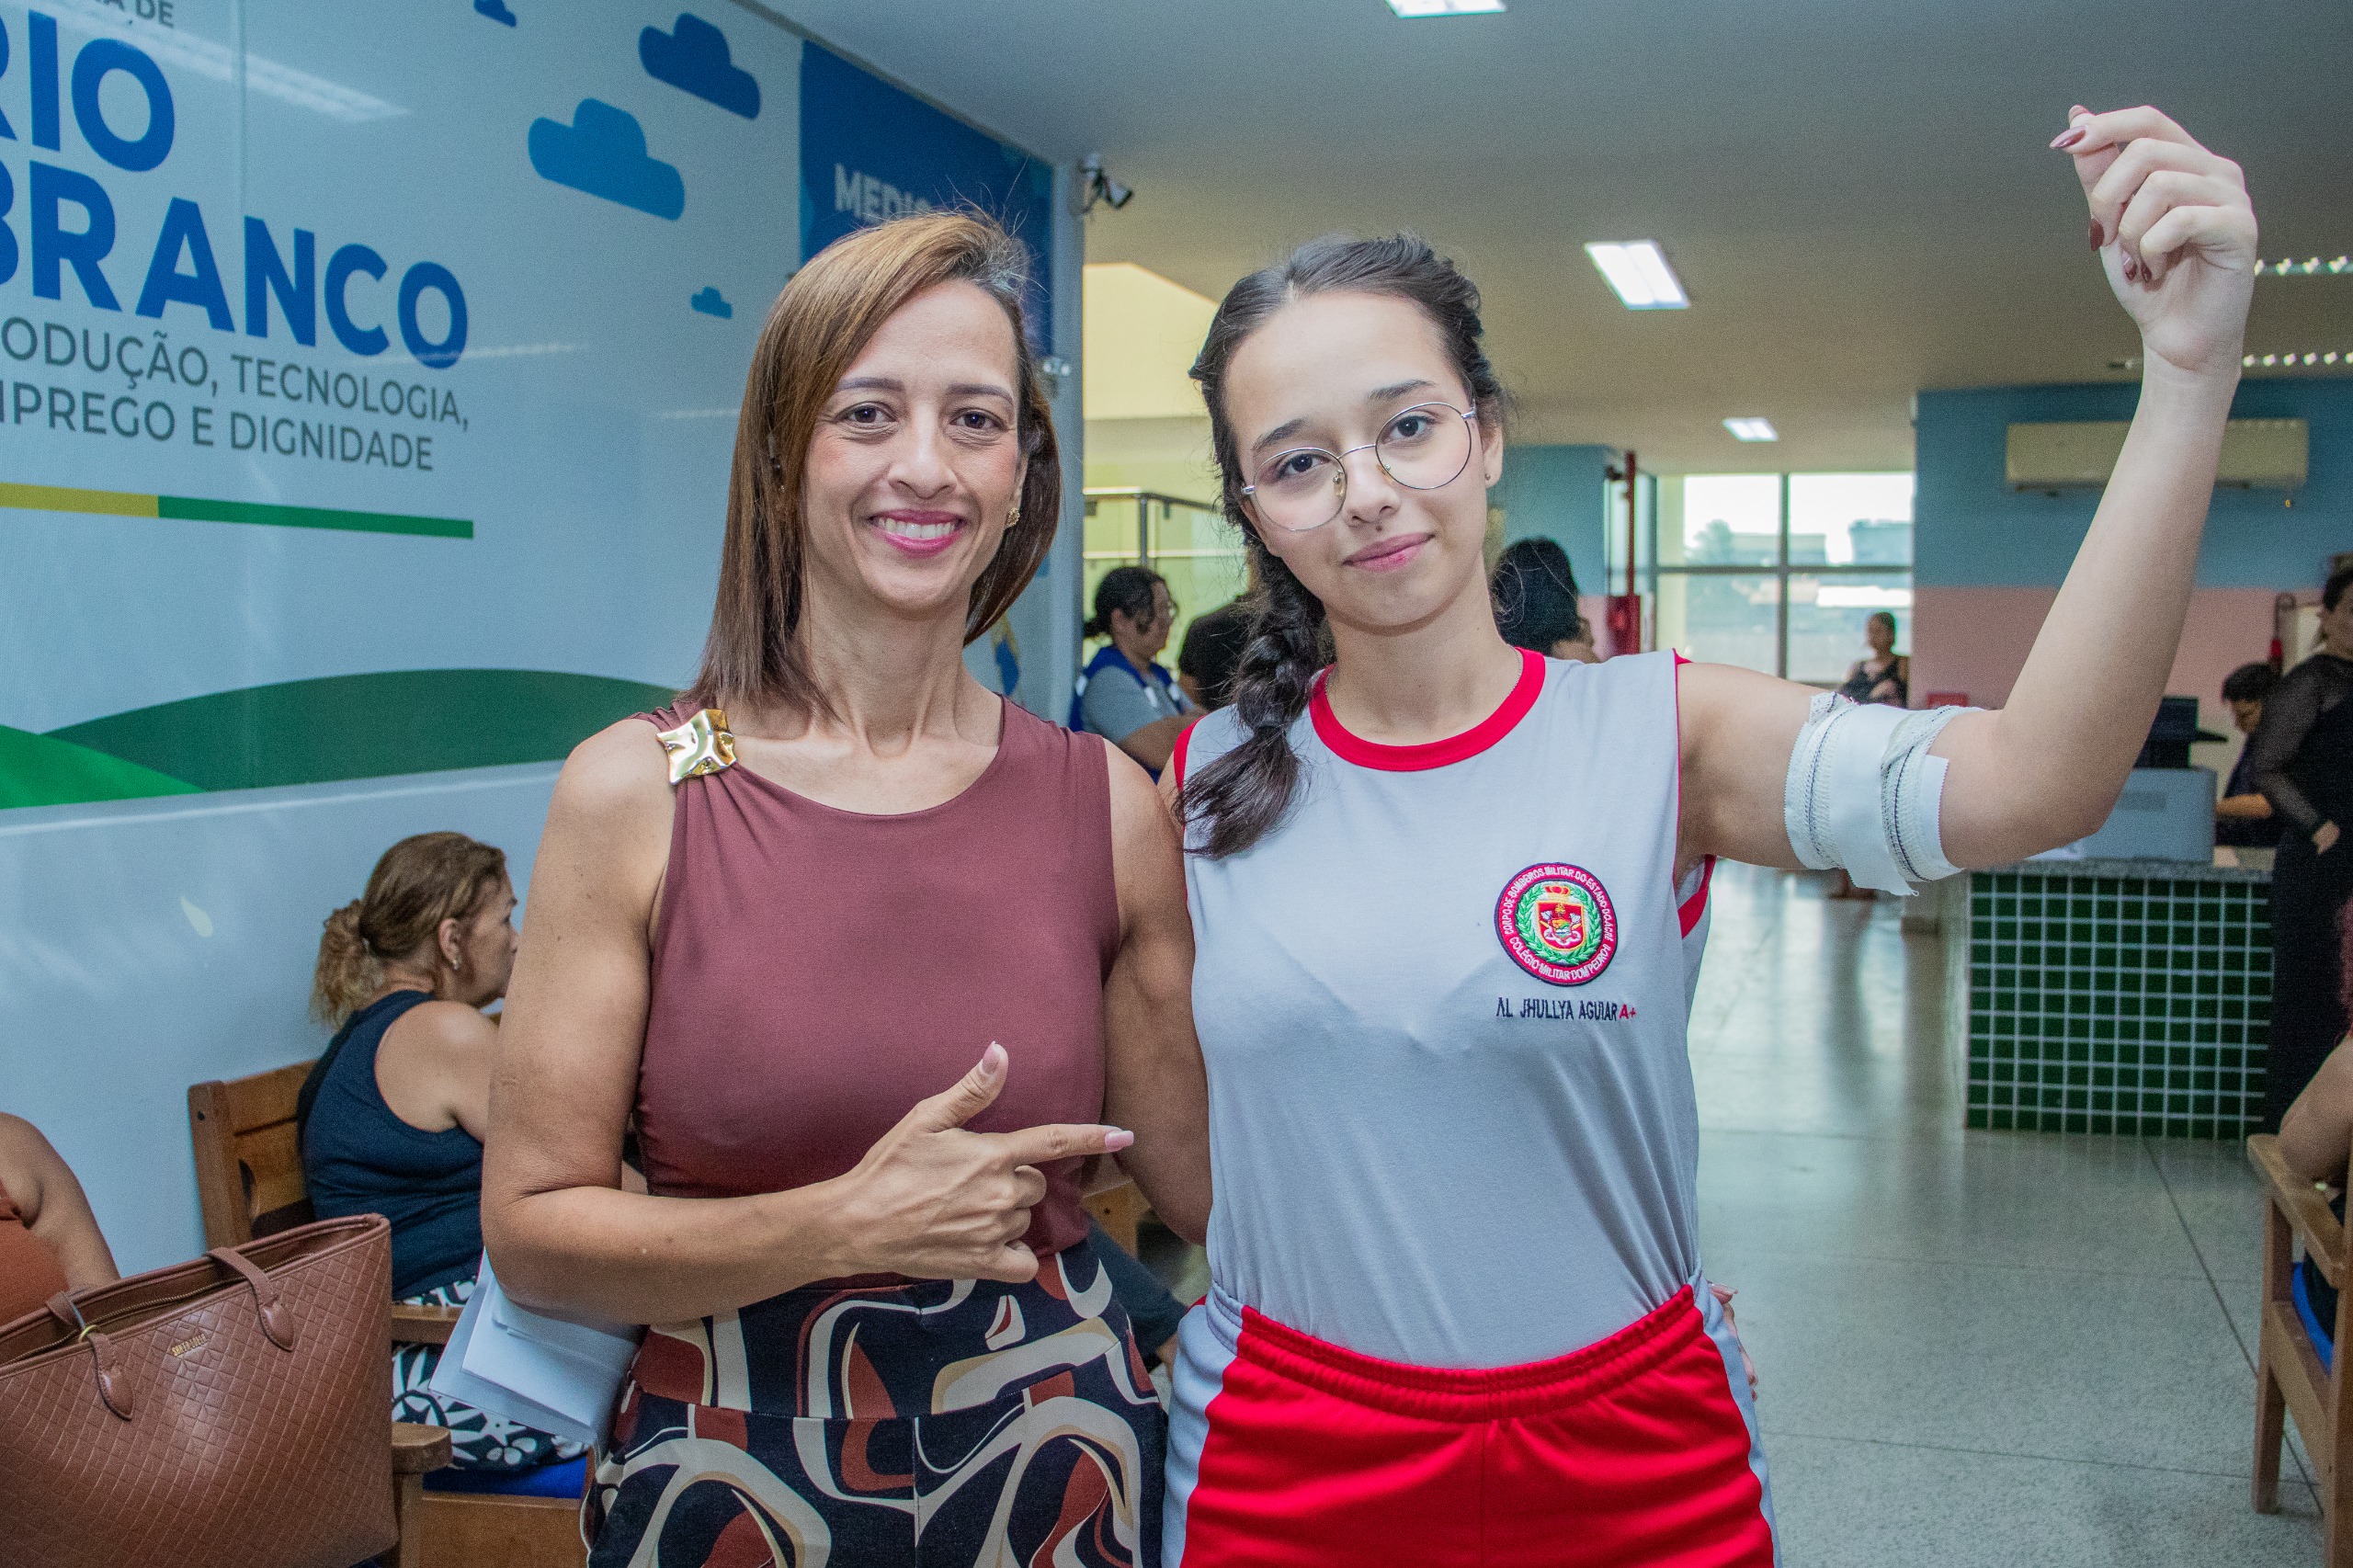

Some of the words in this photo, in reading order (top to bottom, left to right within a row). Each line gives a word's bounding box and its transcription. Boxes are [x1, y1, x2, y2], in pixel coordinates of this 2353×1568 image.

[136, 0, 175, 28] DE
[0, 9, 175, 172] IO
[835, 163, 931, 222] MEDI
[0, 158, 468, 369] RANCO
[1, 316, 218, 397] ODUÇÃO,
[231, 354, 469, 432] TECNOLOGIA,
[0, 379, 176, 442] PREGO
[192, 405, 214, 447] E
[231, 411, 433, 472] DIGNIDADE
[1502, 909, 1515, 935] CORPO
[1544, 866, 1574, 878] MILITAR
[1586, 878, 1608, 907] ESTADO
[1509, 937, 1540, 970] COLÉGIO
[1539, 962, 1571, 980] MILITAR
[1572, 964, 1590, 980] DOM
[1588, 949, 1608, 973] PEDRO
[1495, 997, 1513, 1017] AL
[1519, 998, 1574, 1020] JHULLYA
[1578, 1000, 1618, 1021] AGUIAR
